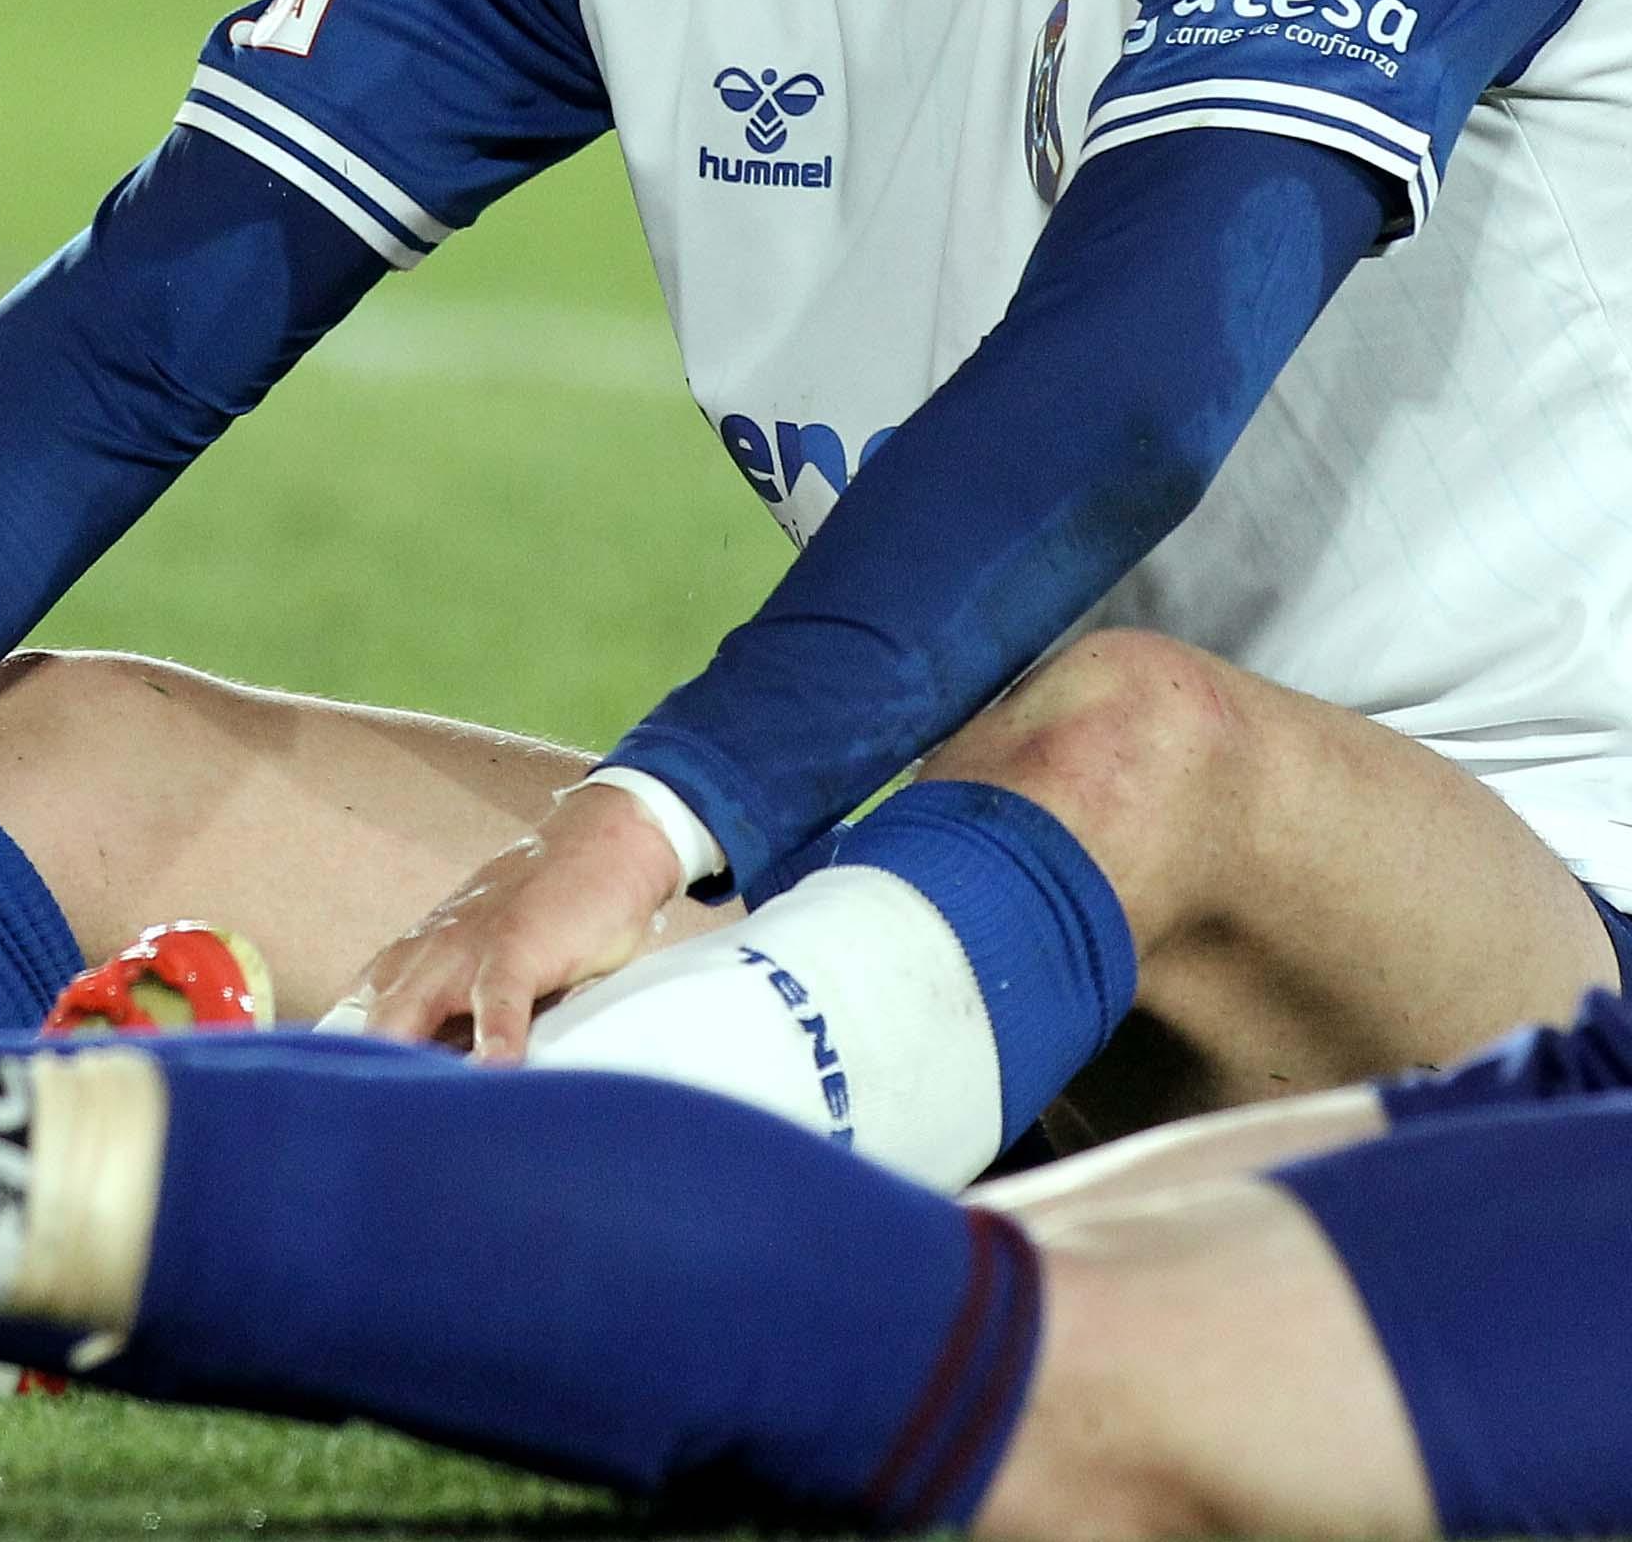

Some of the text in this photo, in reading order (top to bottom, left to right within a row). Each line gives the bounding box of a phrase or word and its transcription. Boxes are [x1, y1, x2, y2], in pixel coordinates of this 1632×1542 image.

[1165, 26, 1245, 45] carnes
[1284, 24, 1399, 78] confianza
[699, 146, 832, 188] hummel
